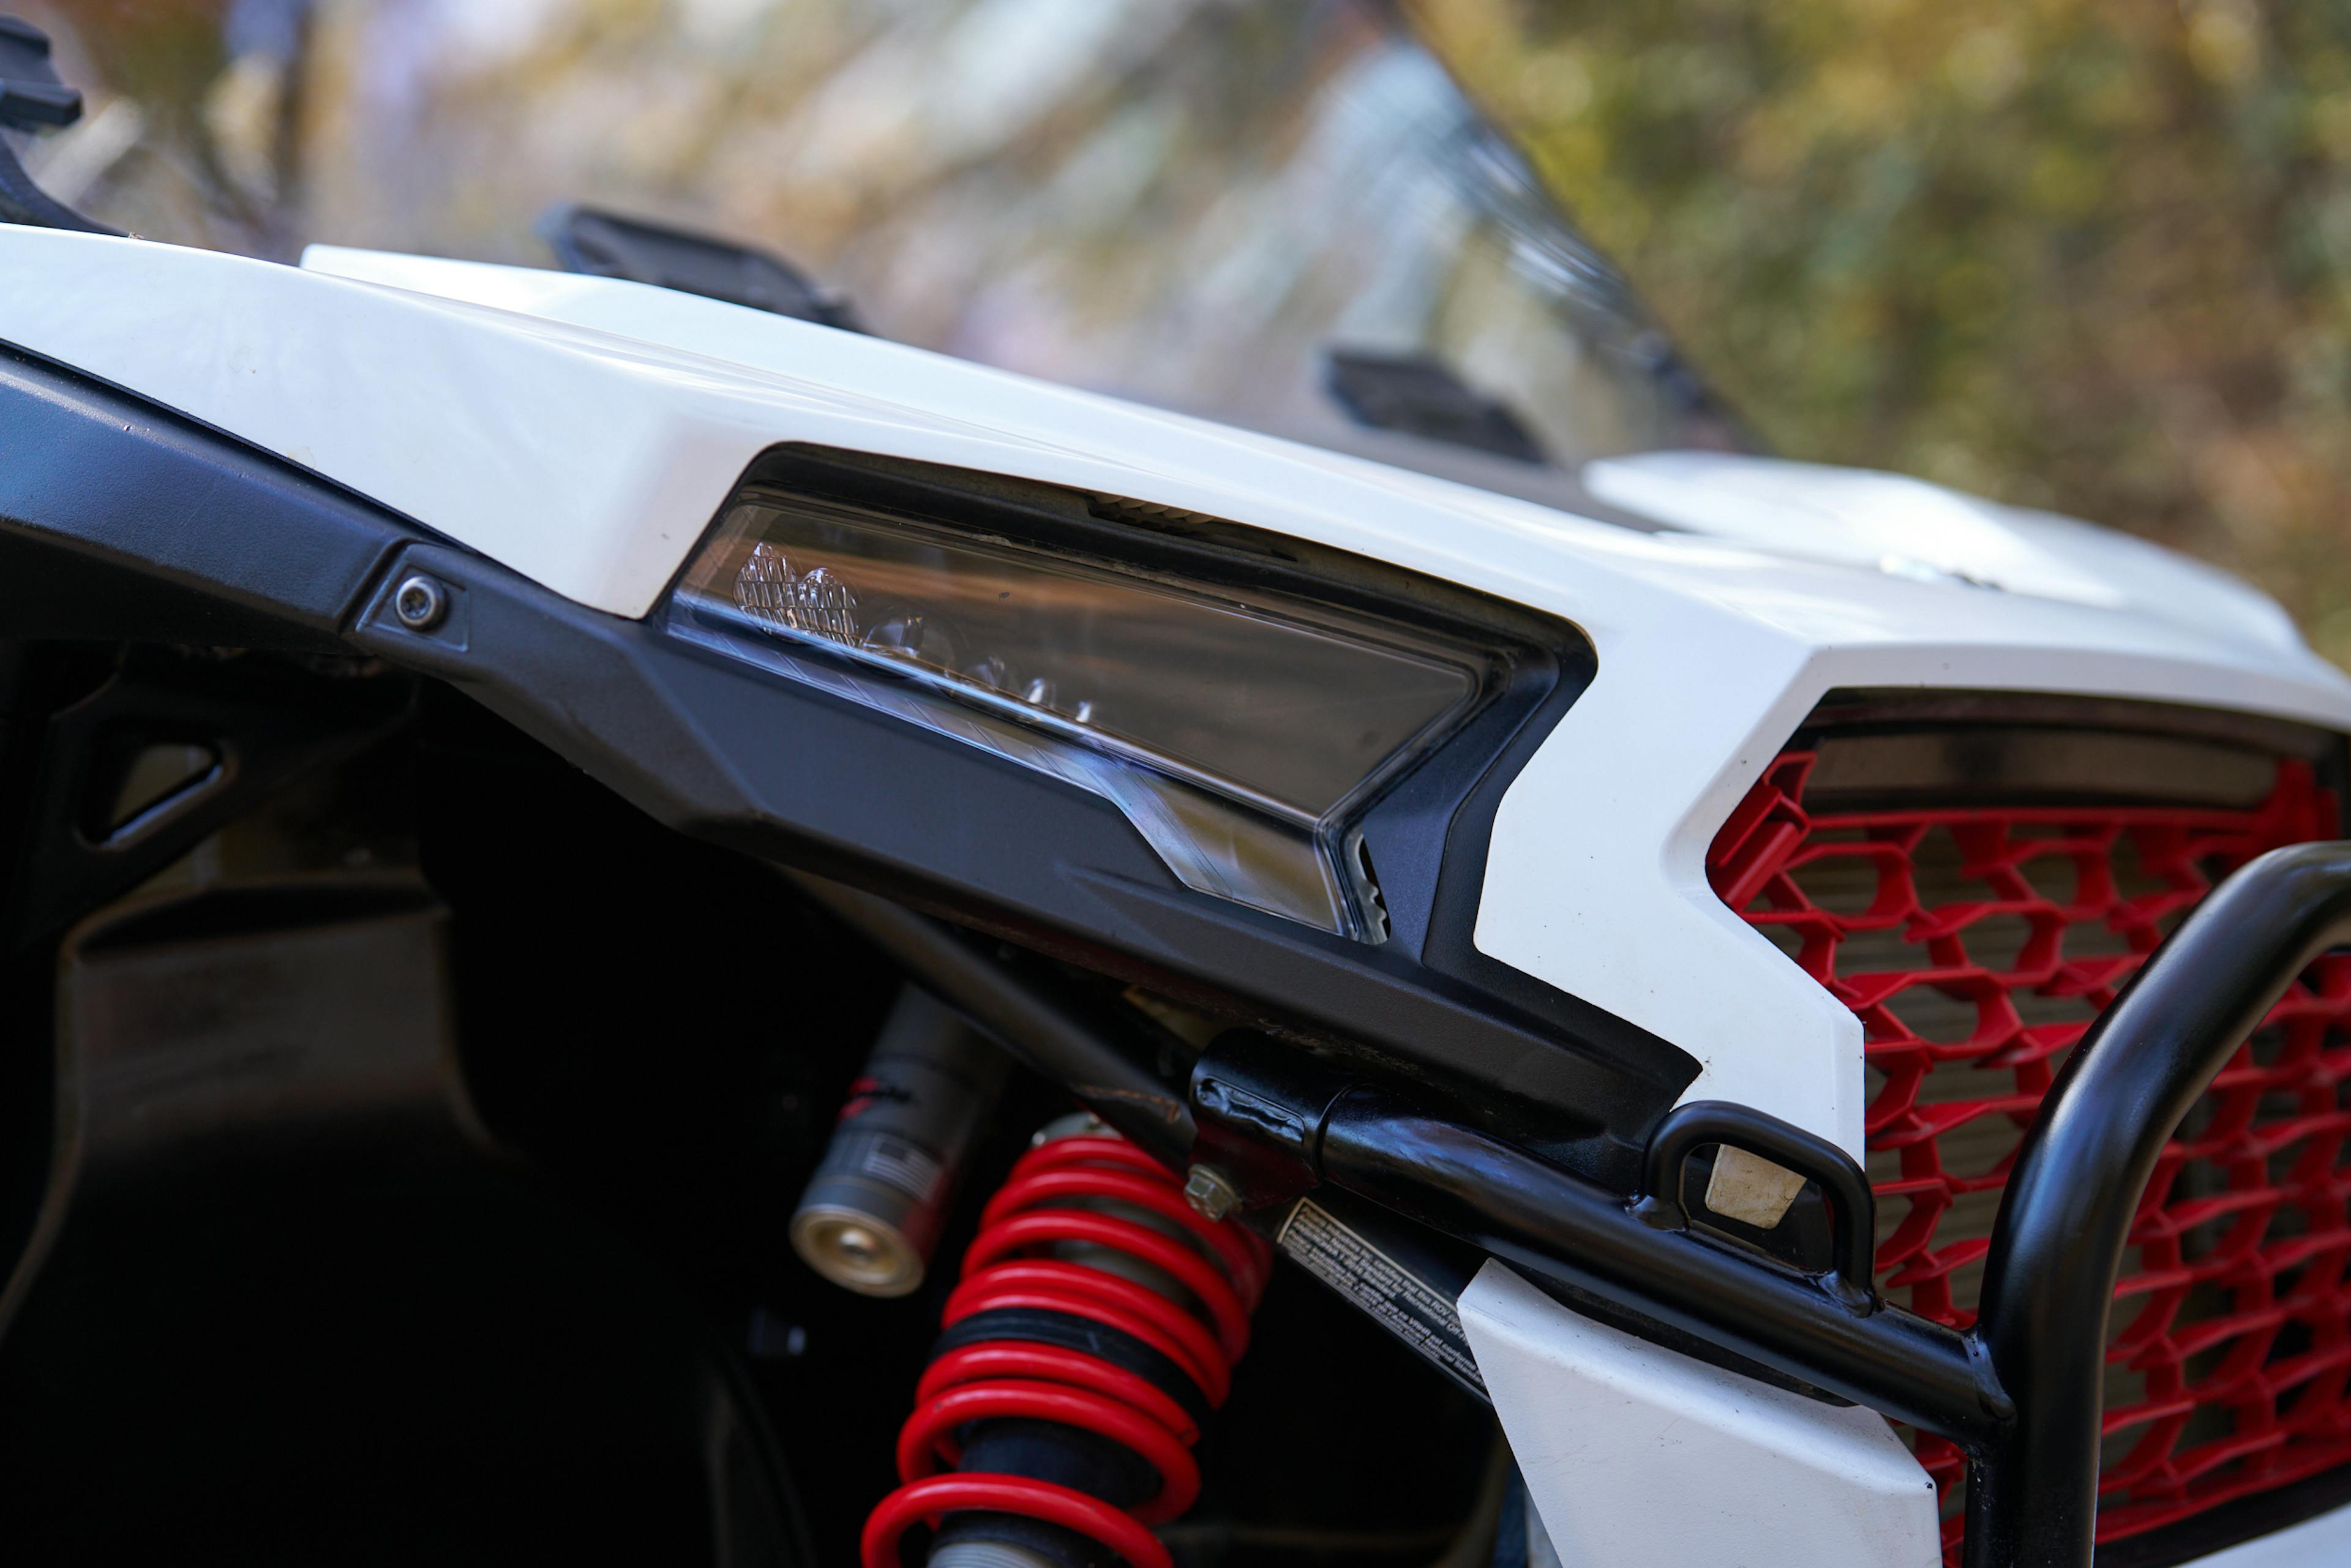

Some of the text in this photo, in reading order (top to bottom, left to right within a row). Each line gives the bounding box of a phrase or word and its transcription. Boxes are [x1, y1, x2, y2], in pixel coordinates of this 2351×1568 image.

[1401, 1278, 1419, 1296] that
[1416, 1289, 1433, 1305] this
[1430, 1299, 1450, 1318] ROV
